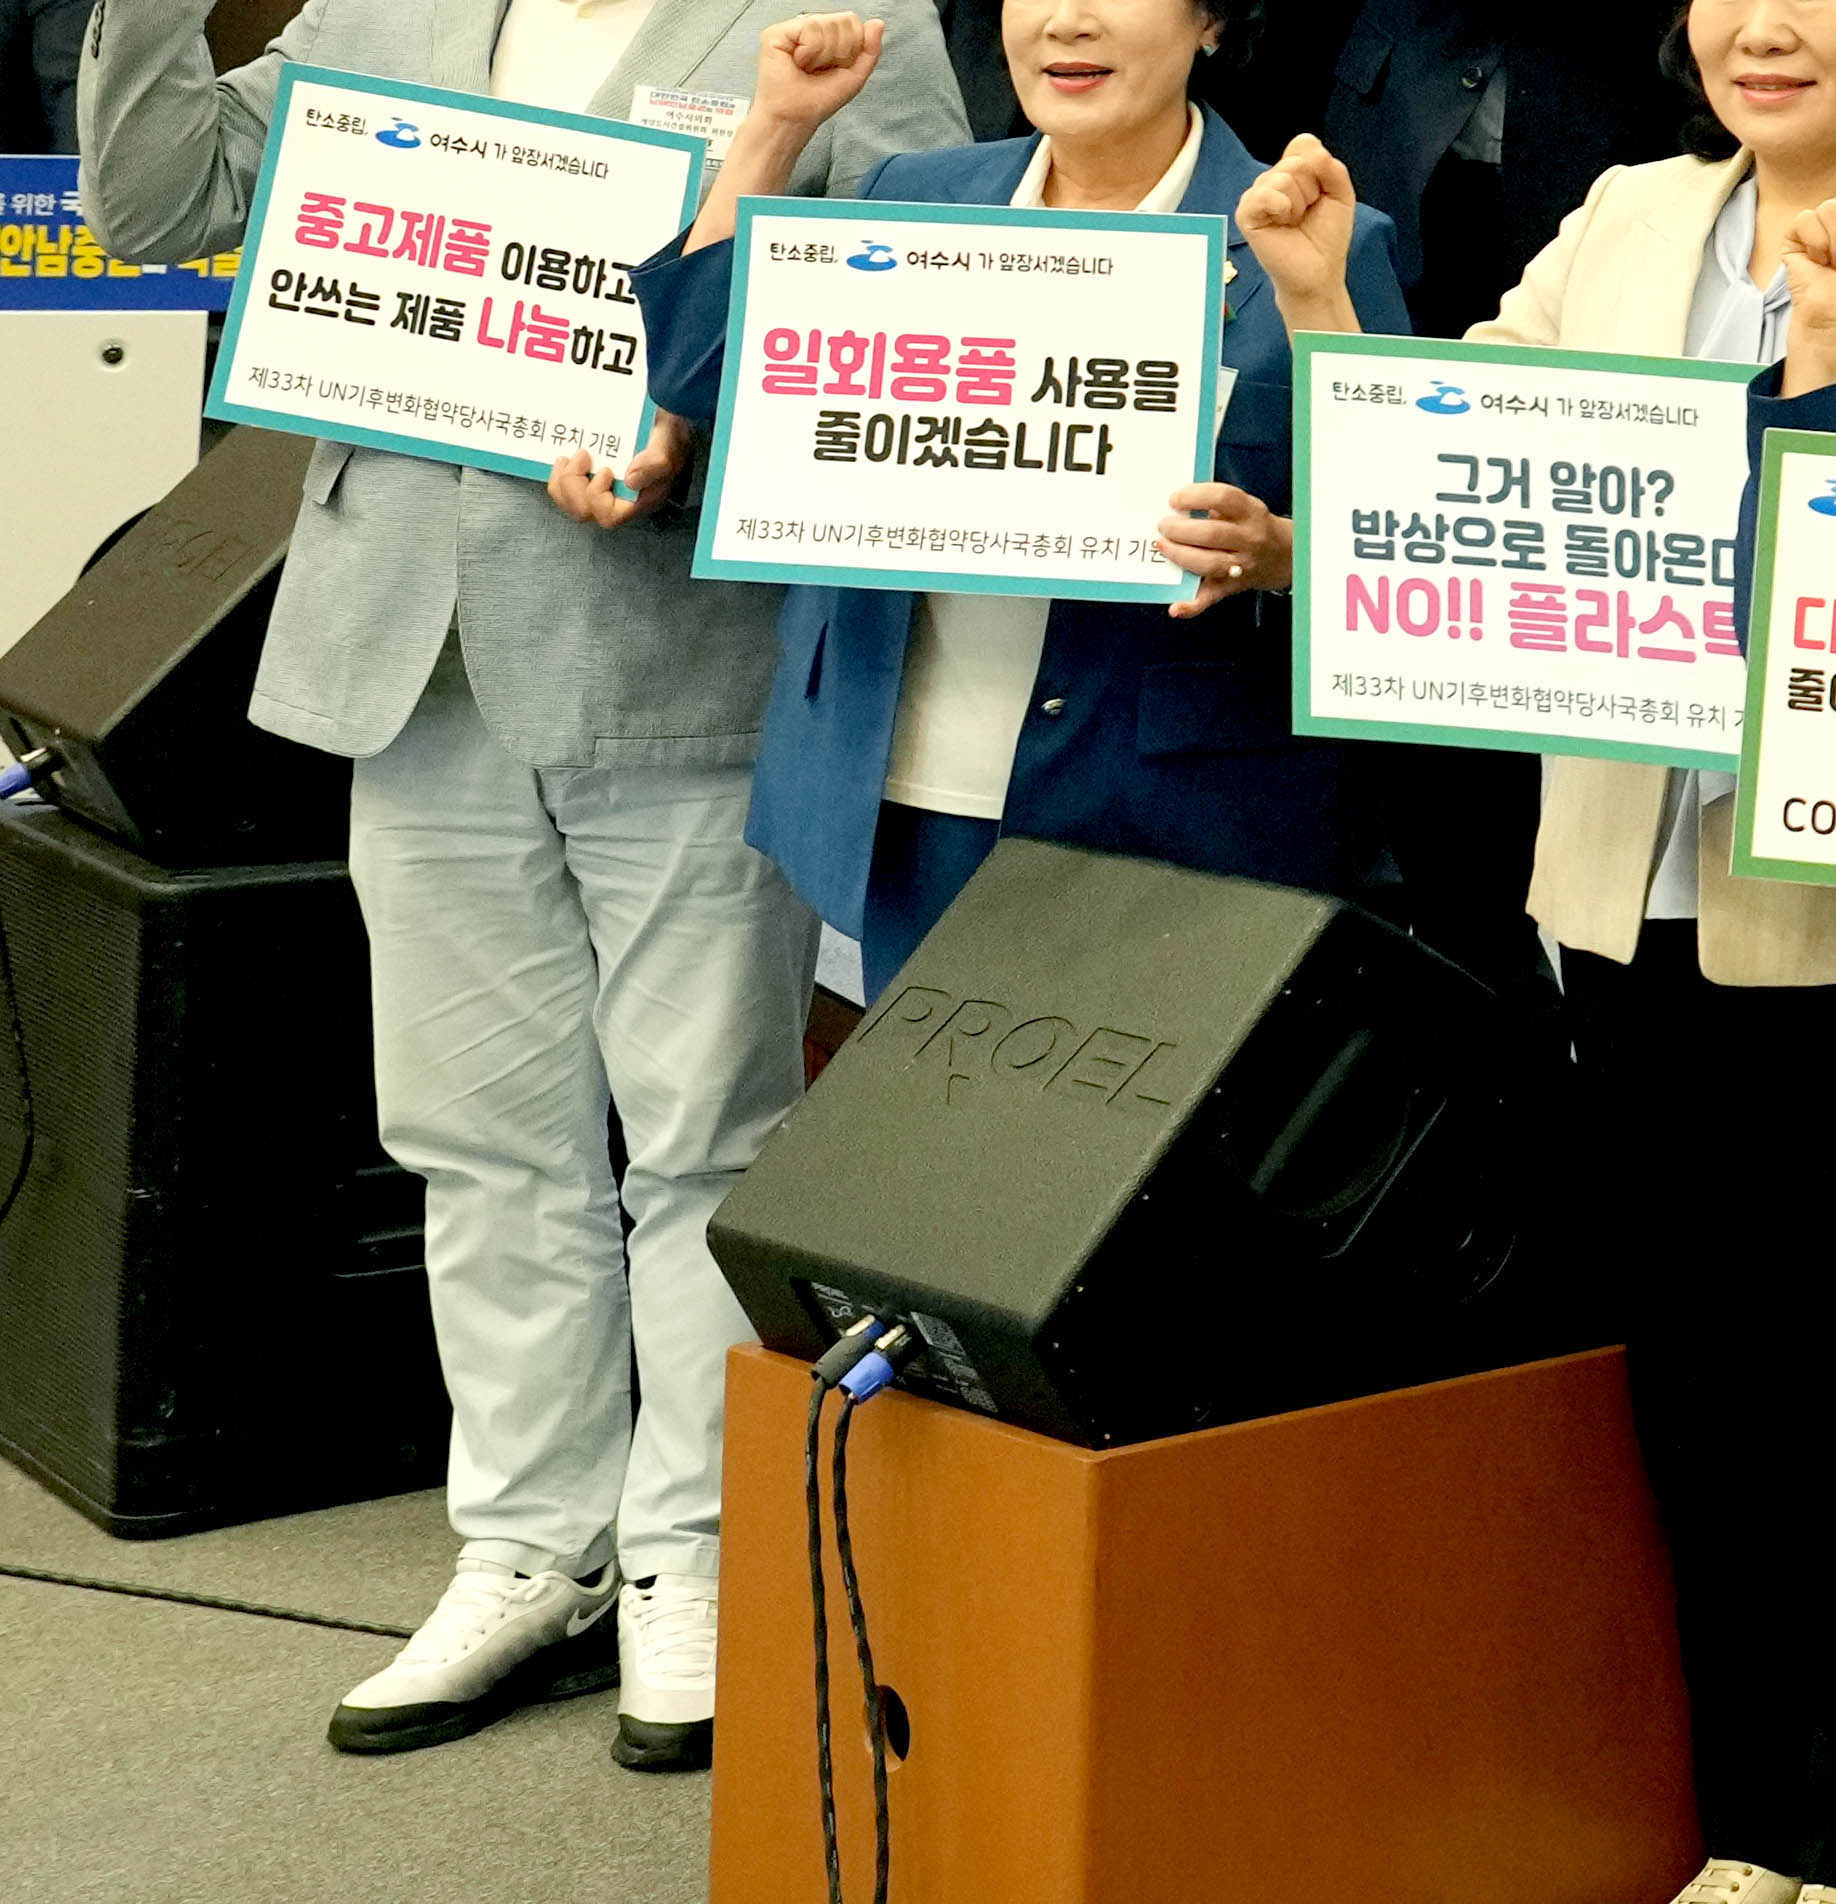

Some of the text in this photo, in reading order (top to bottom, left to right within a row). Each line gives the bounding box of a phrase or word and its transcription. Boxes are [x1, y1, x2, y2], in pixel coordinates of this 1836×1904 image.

[295, 192, 637, 305] 중고제품 이용하고
[269, 269, 637, 375] 안쓰는 제품 나눔하고
[762, 328, 1179, 412] 일회용품 사용을
[814, 411, 1113, 475] 줄이겠습니다
[1436, 454, 1674, 518] 그거 알아?
[1352, 509, 1546, 571] 밥상으로
[1346, 574, 1483, 641] NO!!
[855, 985, 1177, 1108] PROEL
